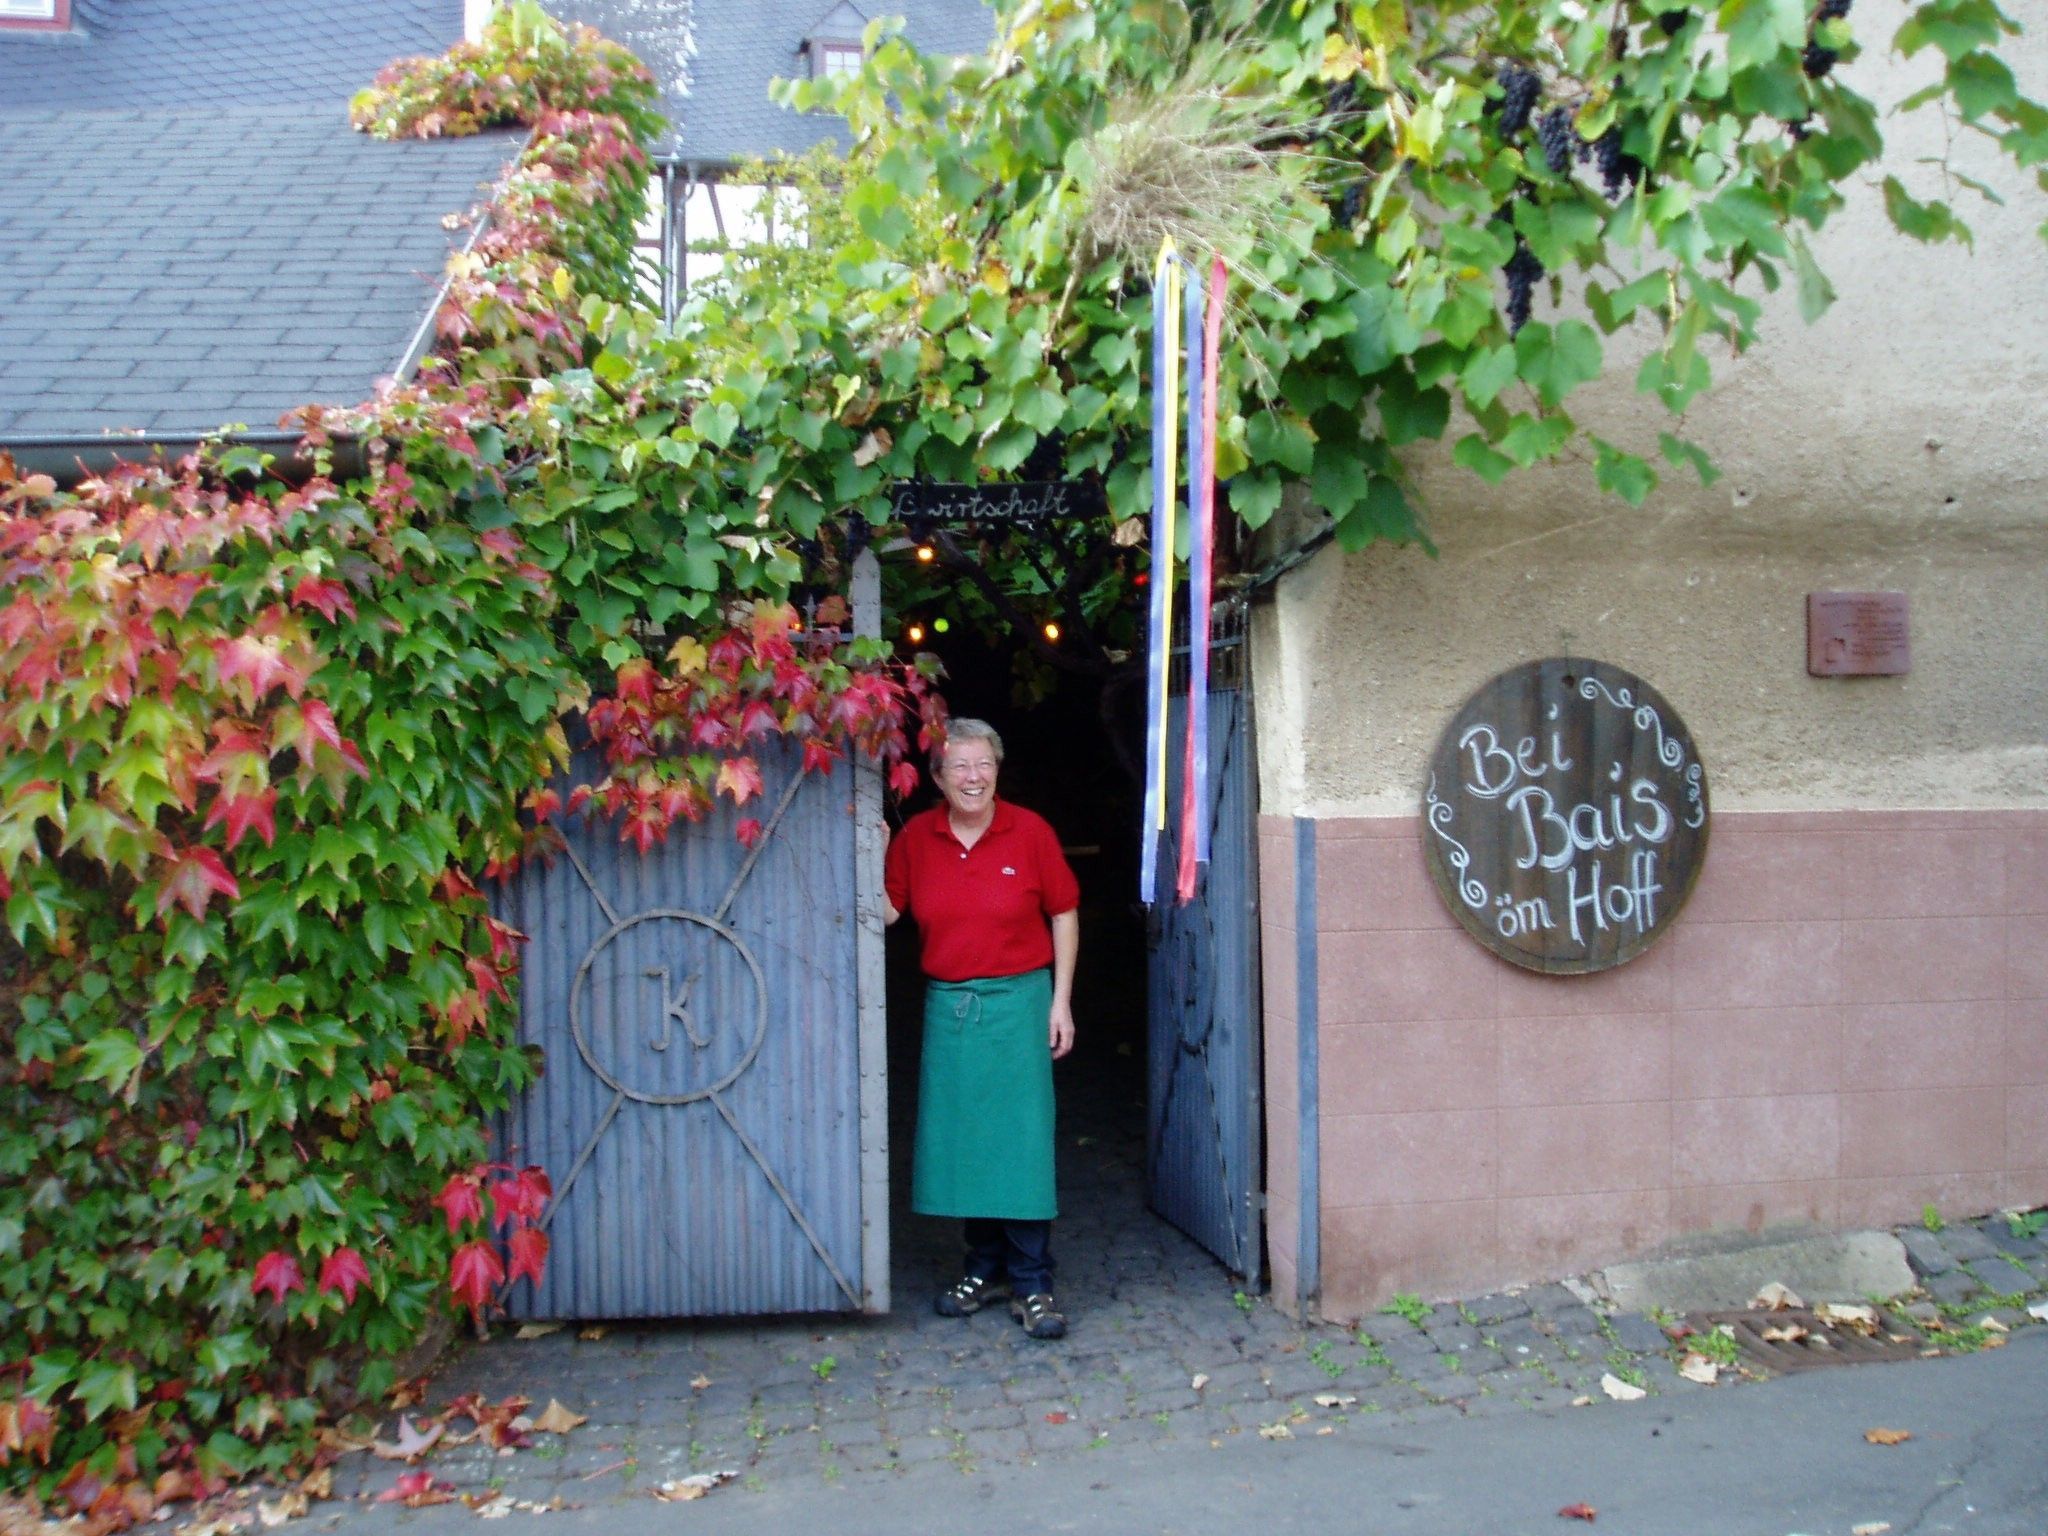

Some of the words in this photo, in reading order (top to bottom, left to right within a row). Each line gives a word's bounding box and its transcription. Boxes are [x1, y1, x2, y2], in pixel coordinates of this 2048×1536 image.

[1459, 703, 1573, 799] Bei
[1496, 893, 1556, 937] öm
[1567, 850, 1663, 946] Hoff
[645, 966, 714, 1051] K
